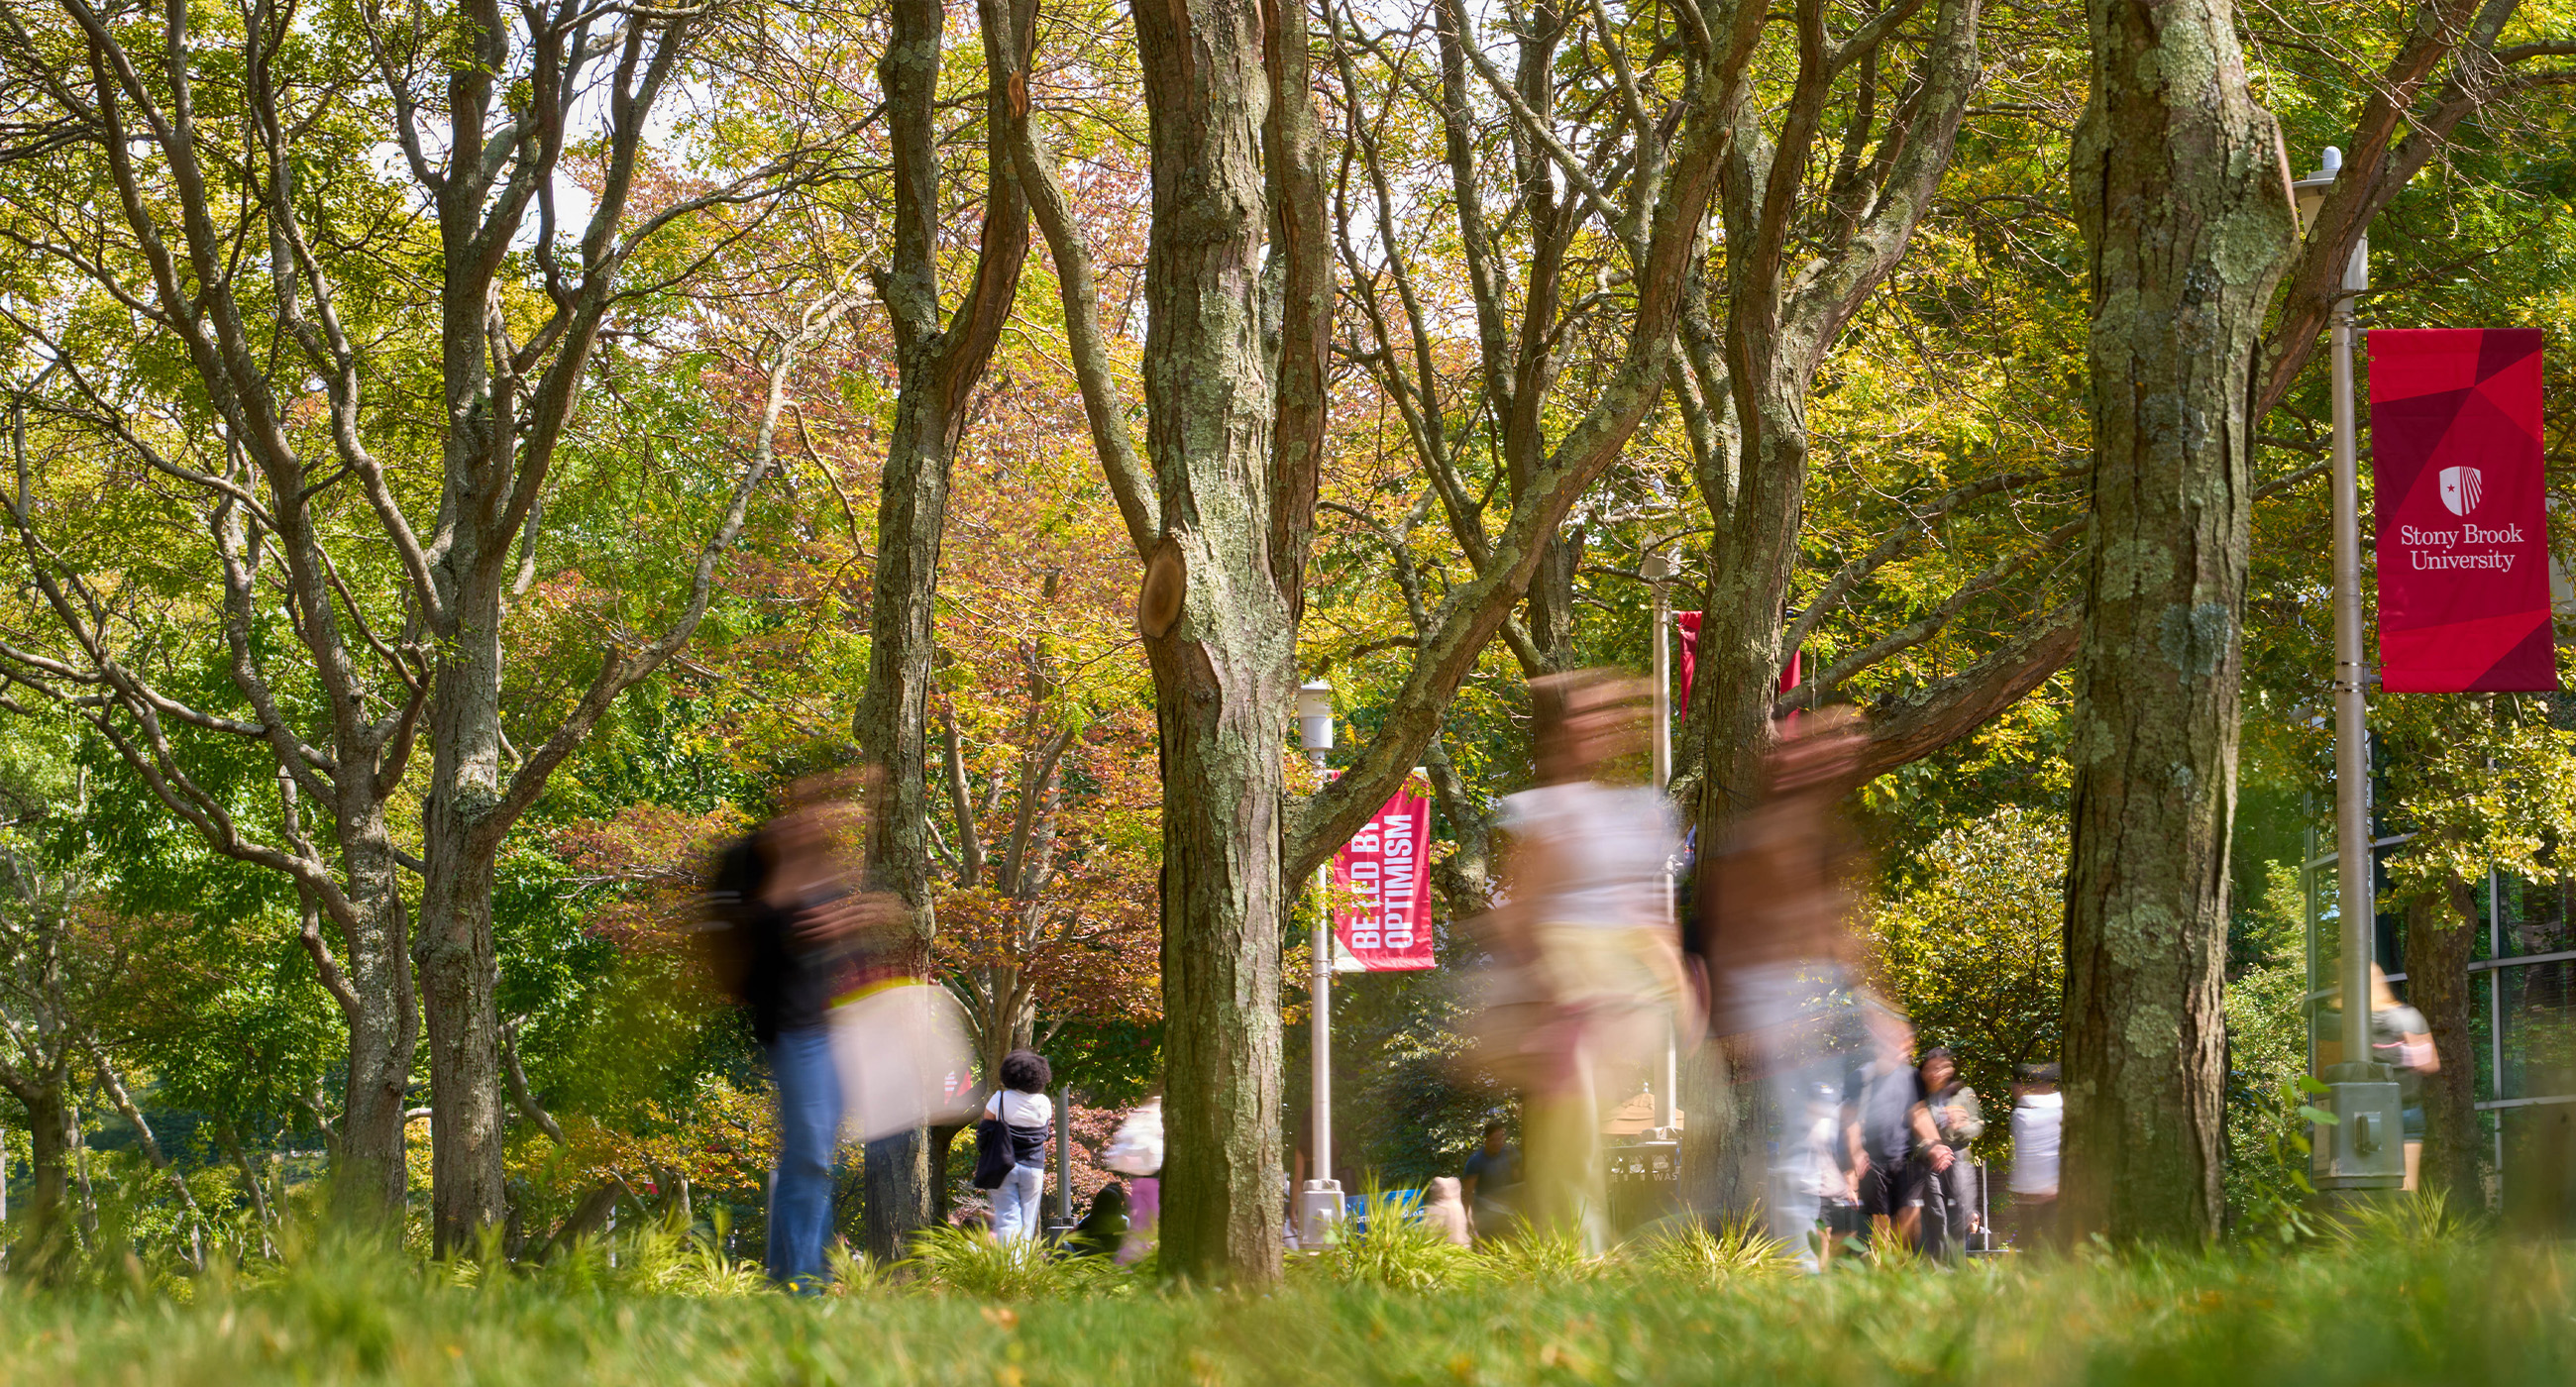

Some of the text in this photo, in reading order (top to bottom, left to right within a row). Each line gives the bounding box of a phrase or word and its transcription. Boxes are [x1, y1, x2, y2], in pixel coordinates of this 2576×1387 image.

[2401, 523, 2524, 549] Stony Brook
[2411, 549, 2516, 573] University
[1350, 861, 1380, 907] LED
[1383, 814, 1414, 949] OPTIMISM
[1351, 915, 1381, 949] BE
[1653, 1172, 1678, 1182] WAS
